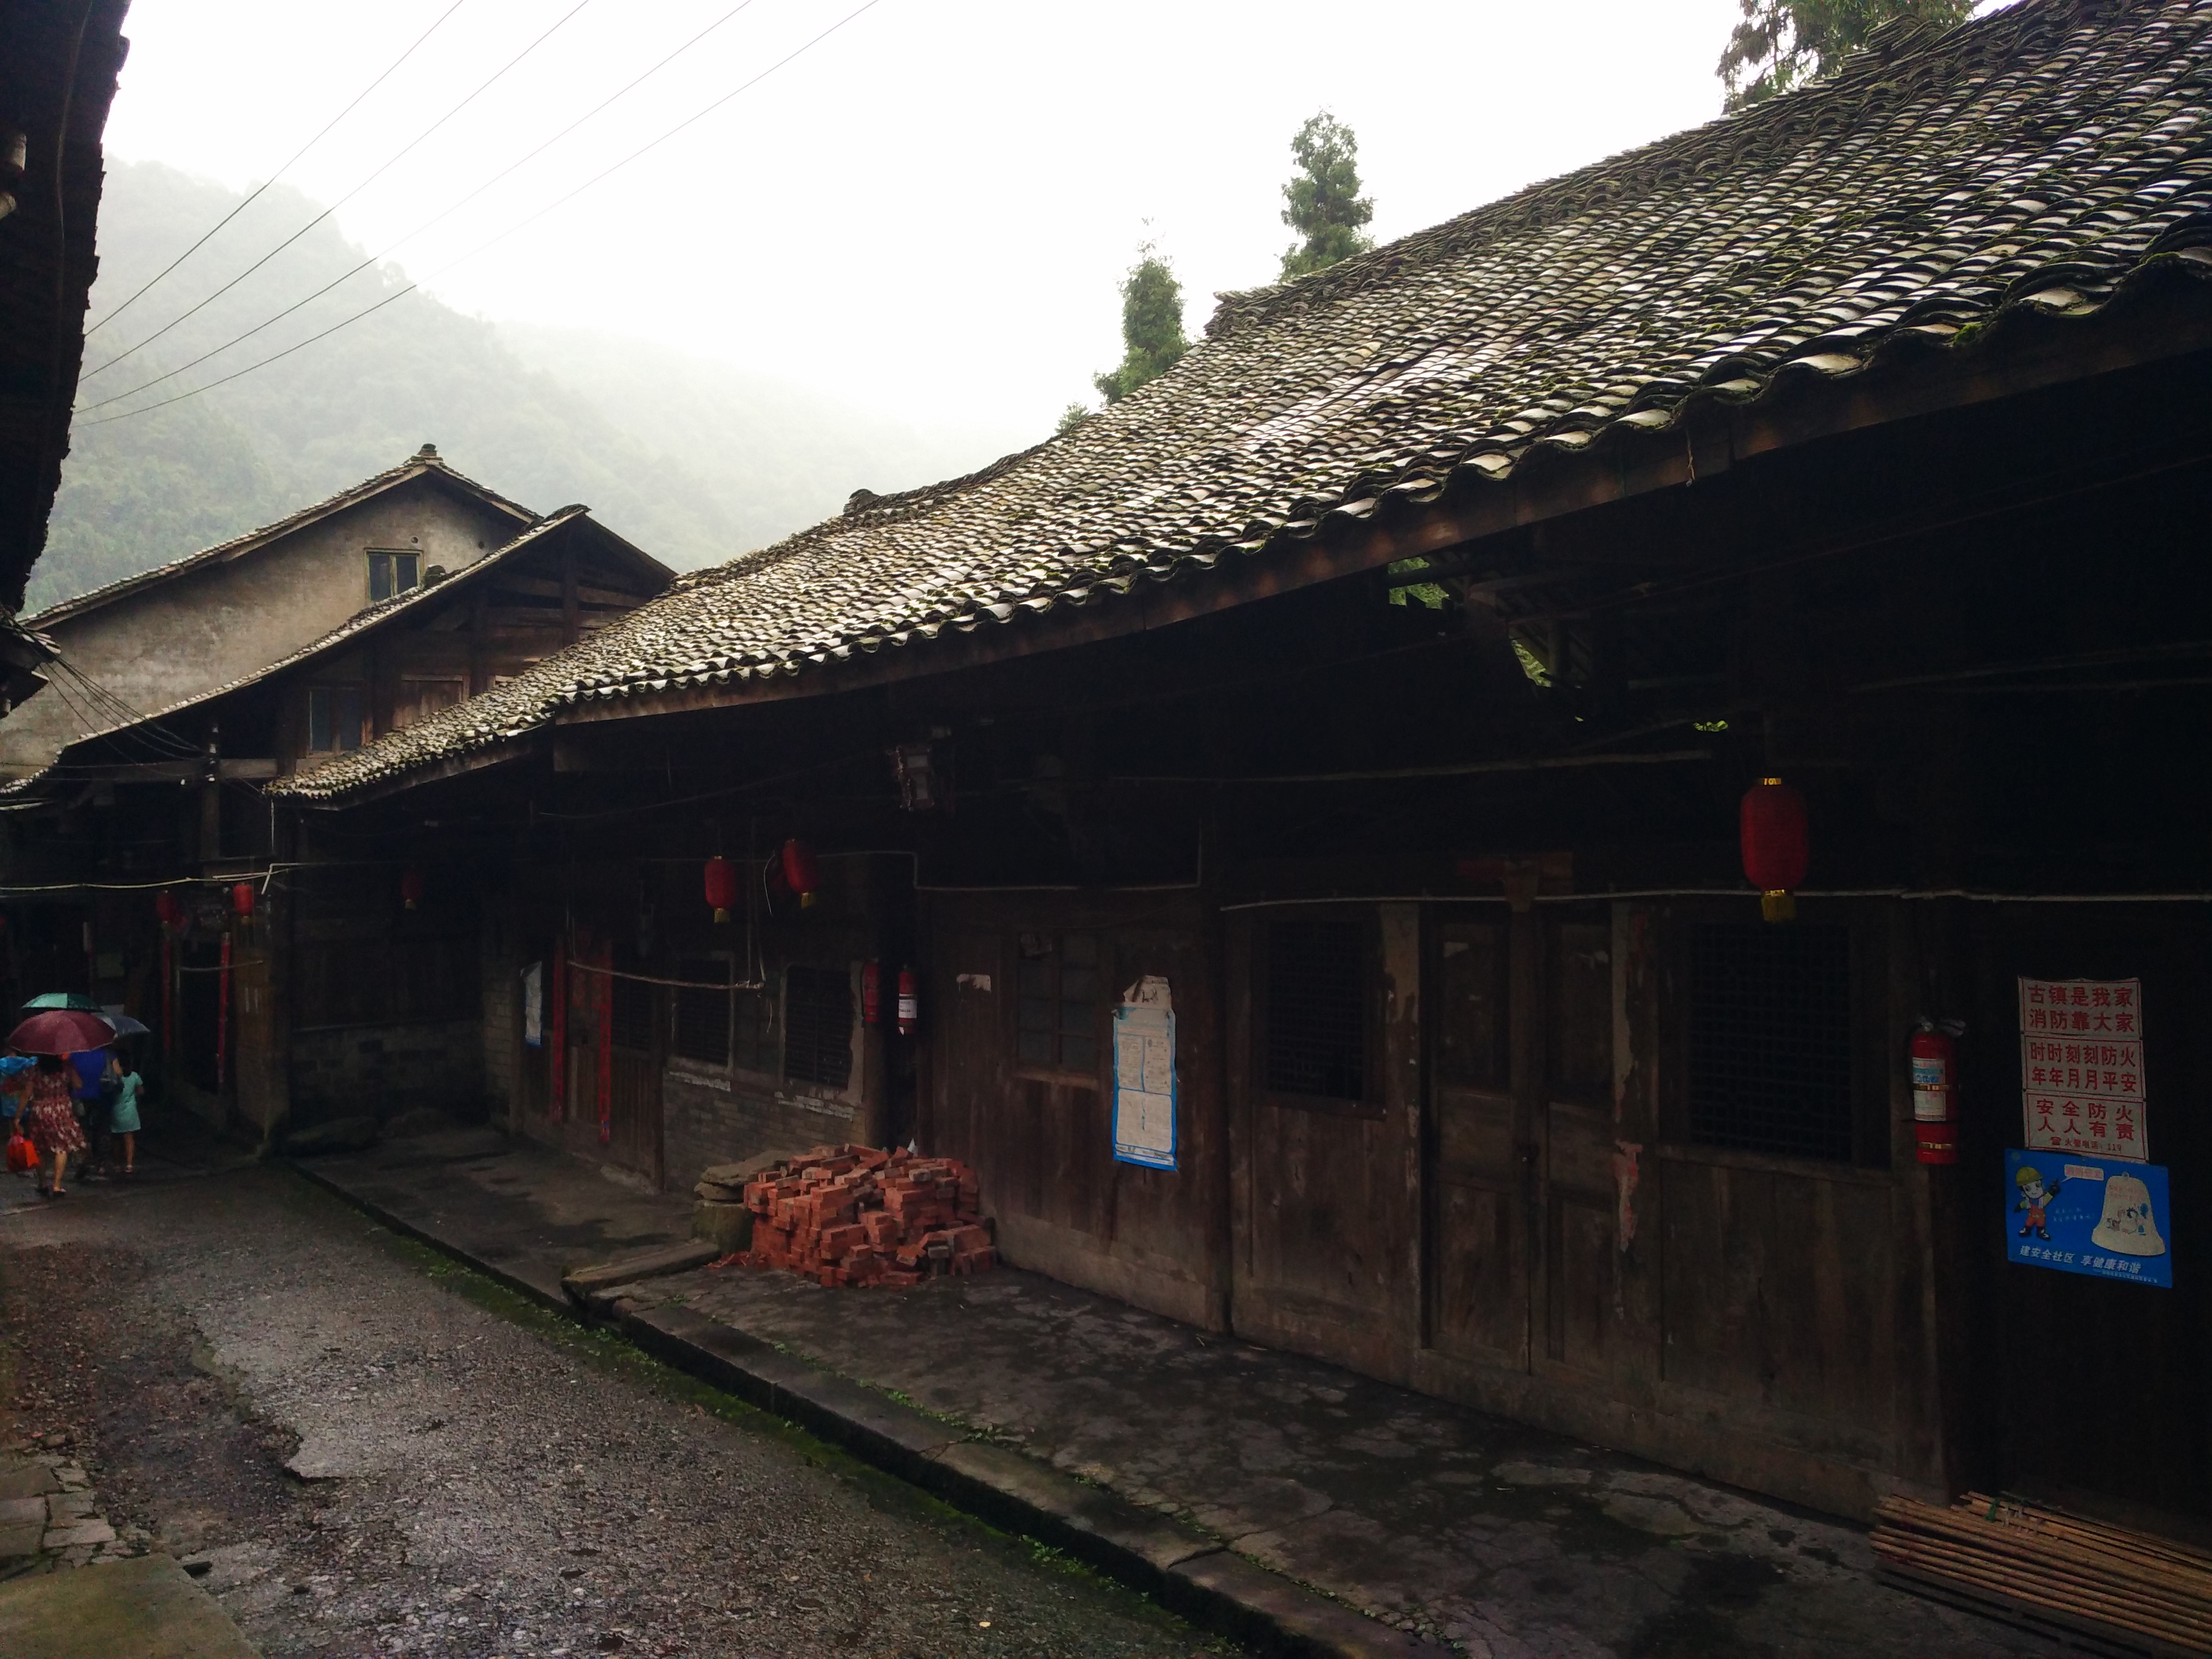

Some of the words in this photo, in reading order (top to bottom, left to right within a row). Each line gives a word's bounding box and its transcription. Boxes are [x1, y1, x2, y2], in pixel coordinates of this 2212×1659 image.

[2028, 985, 2133, 1007] 古镇是我家
[2030, 1009, 2134, 1032] 消防靠大家
[2030, 1043, 2135, 1066] 时时刻刻防火
[2032, 1067, 2136, 1092] 年年月月平安
[2037, 1099, 2133, 1121] 安全防火
[2038, 1117, 2134, 1140] 人人有责
[2019, 1245, 2075, 1263] 建安全社区
[2080, 1255, 2142, 1275] 享健康和谐
